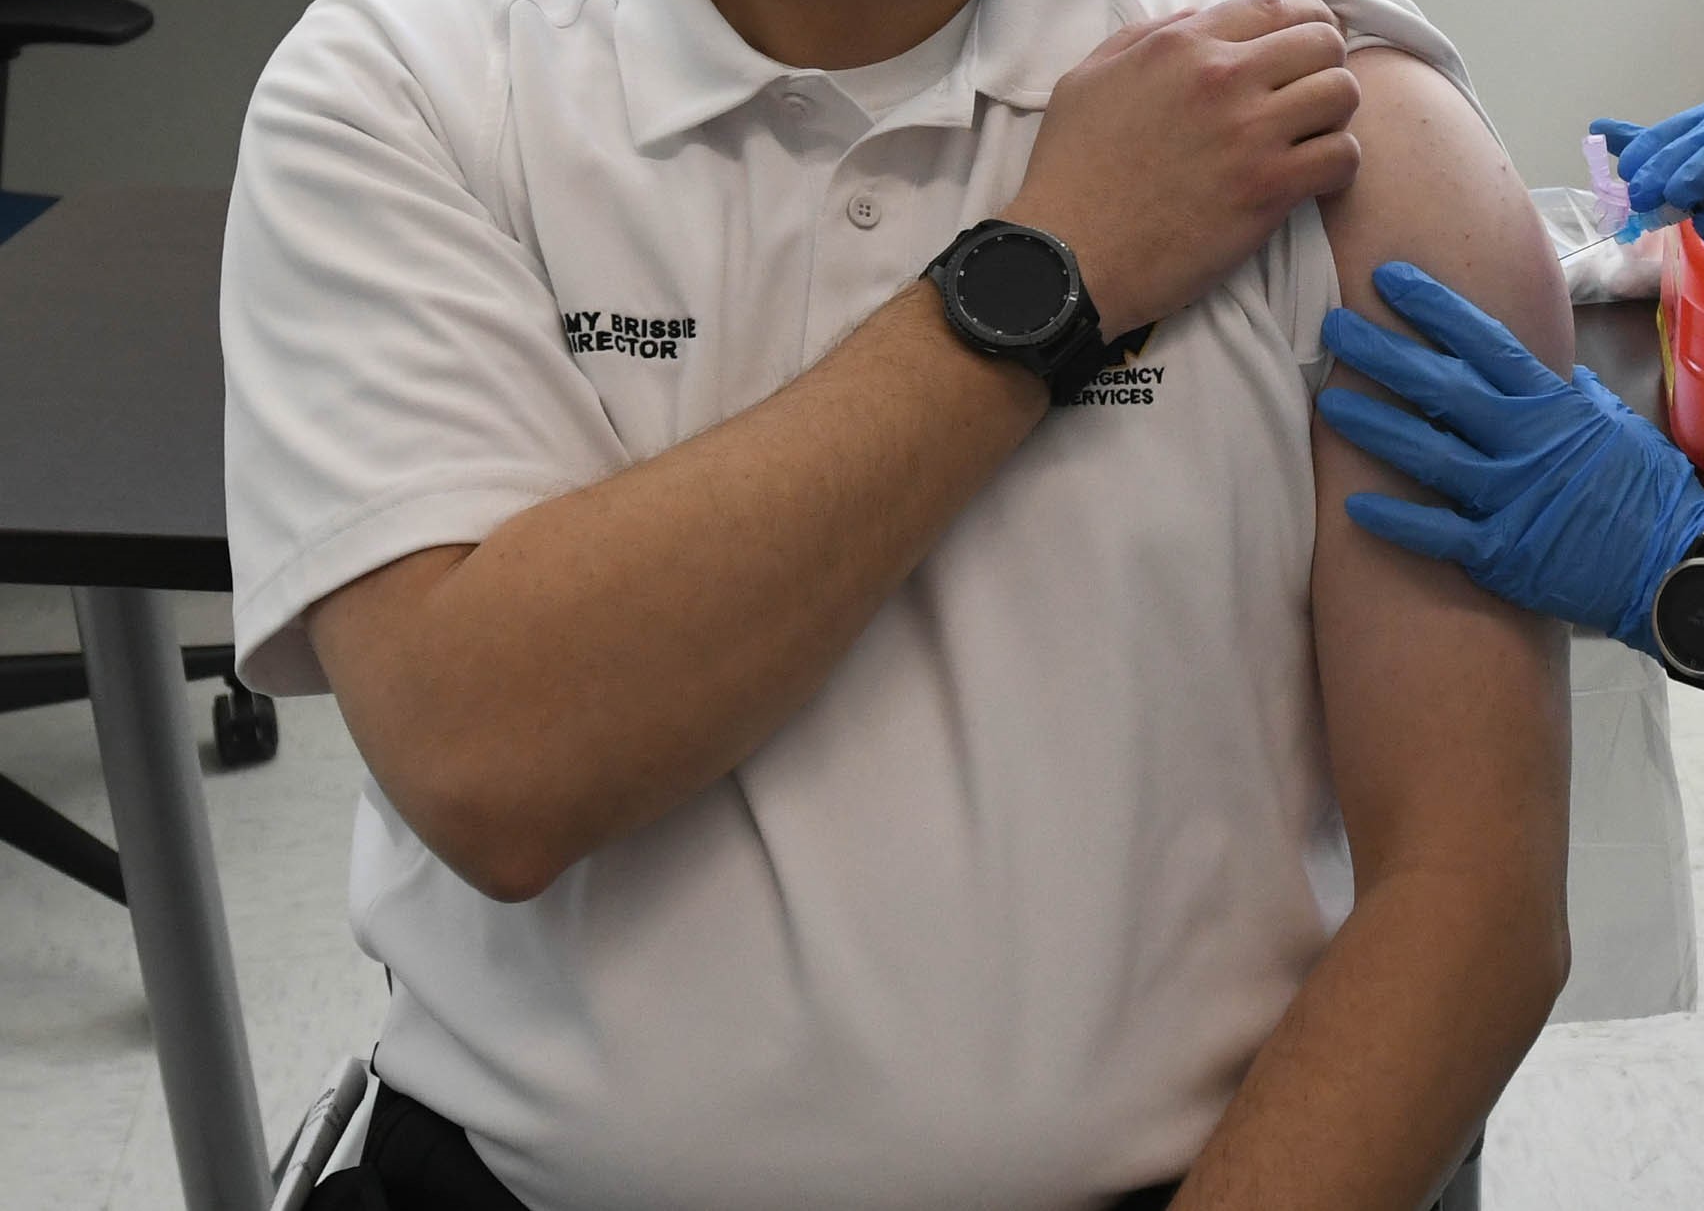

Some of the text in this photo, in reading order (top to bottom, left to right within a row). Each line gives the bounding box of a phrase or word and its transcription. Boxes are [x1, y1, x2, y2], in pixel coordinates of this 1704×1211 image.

[564, 311, 697, 339] MY BRISSIE
[569, 330, 678, 359] IRECTOR
[1067, 388, 1154, 406] ERVICES
